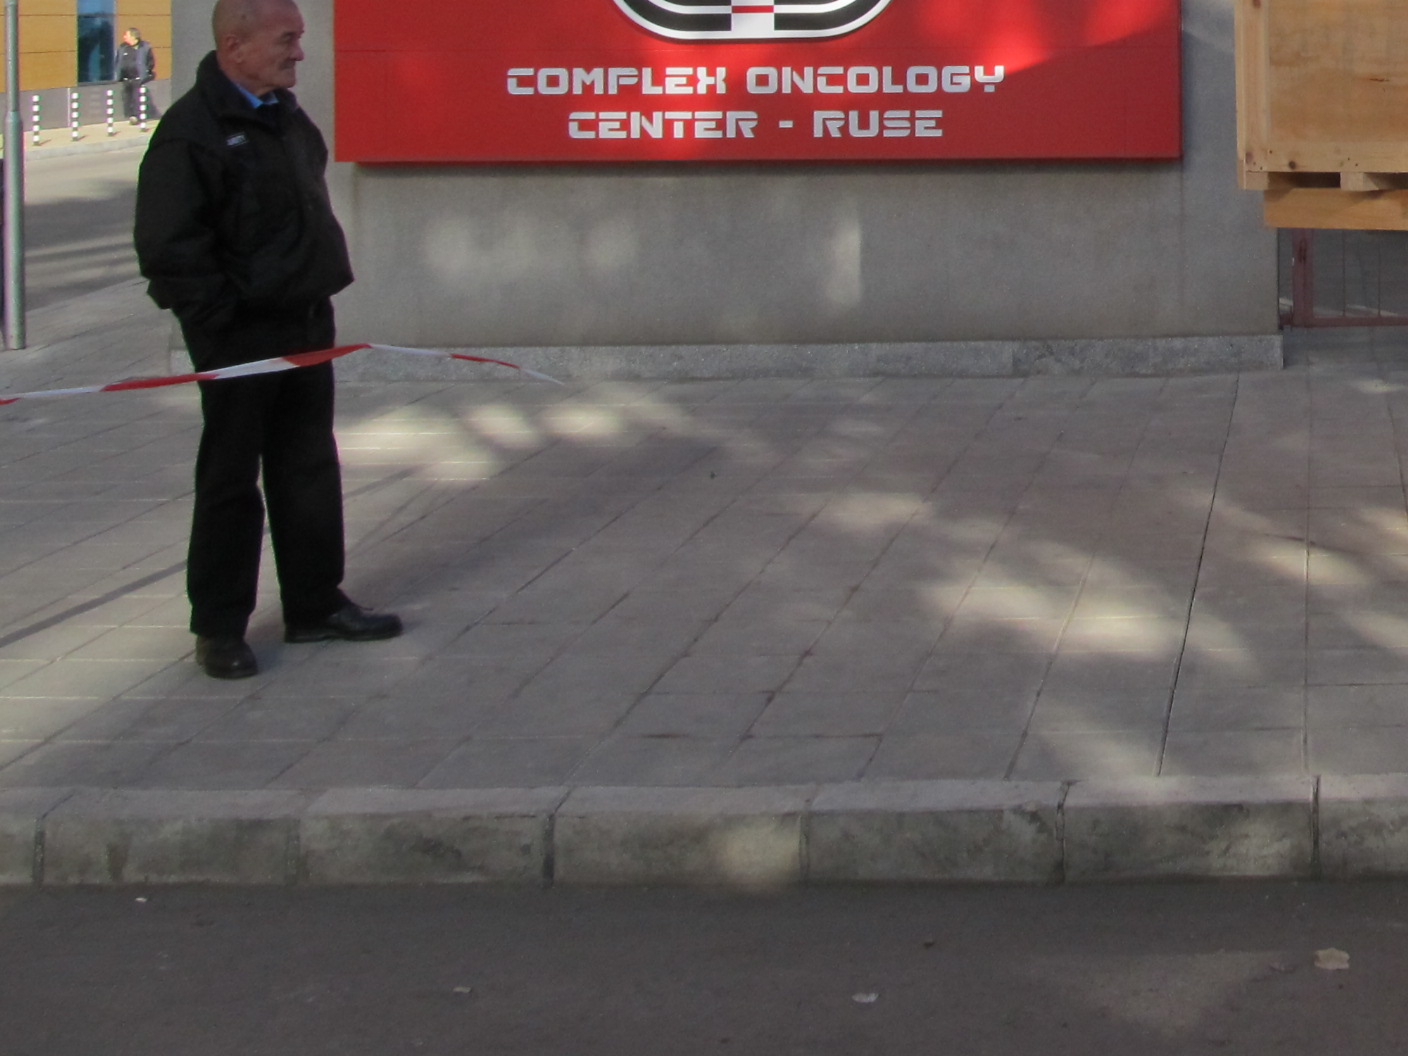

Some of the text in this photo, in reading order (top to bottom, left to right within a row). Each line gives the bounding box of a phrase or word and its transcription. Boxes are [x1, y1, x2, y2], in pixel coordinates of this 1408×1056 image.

[507, 64, 1006, 95] COMPLEX ONCOLOGY
[568, 110, 758, 139] CENTER
[813, 109, 943, 138] RUSE
